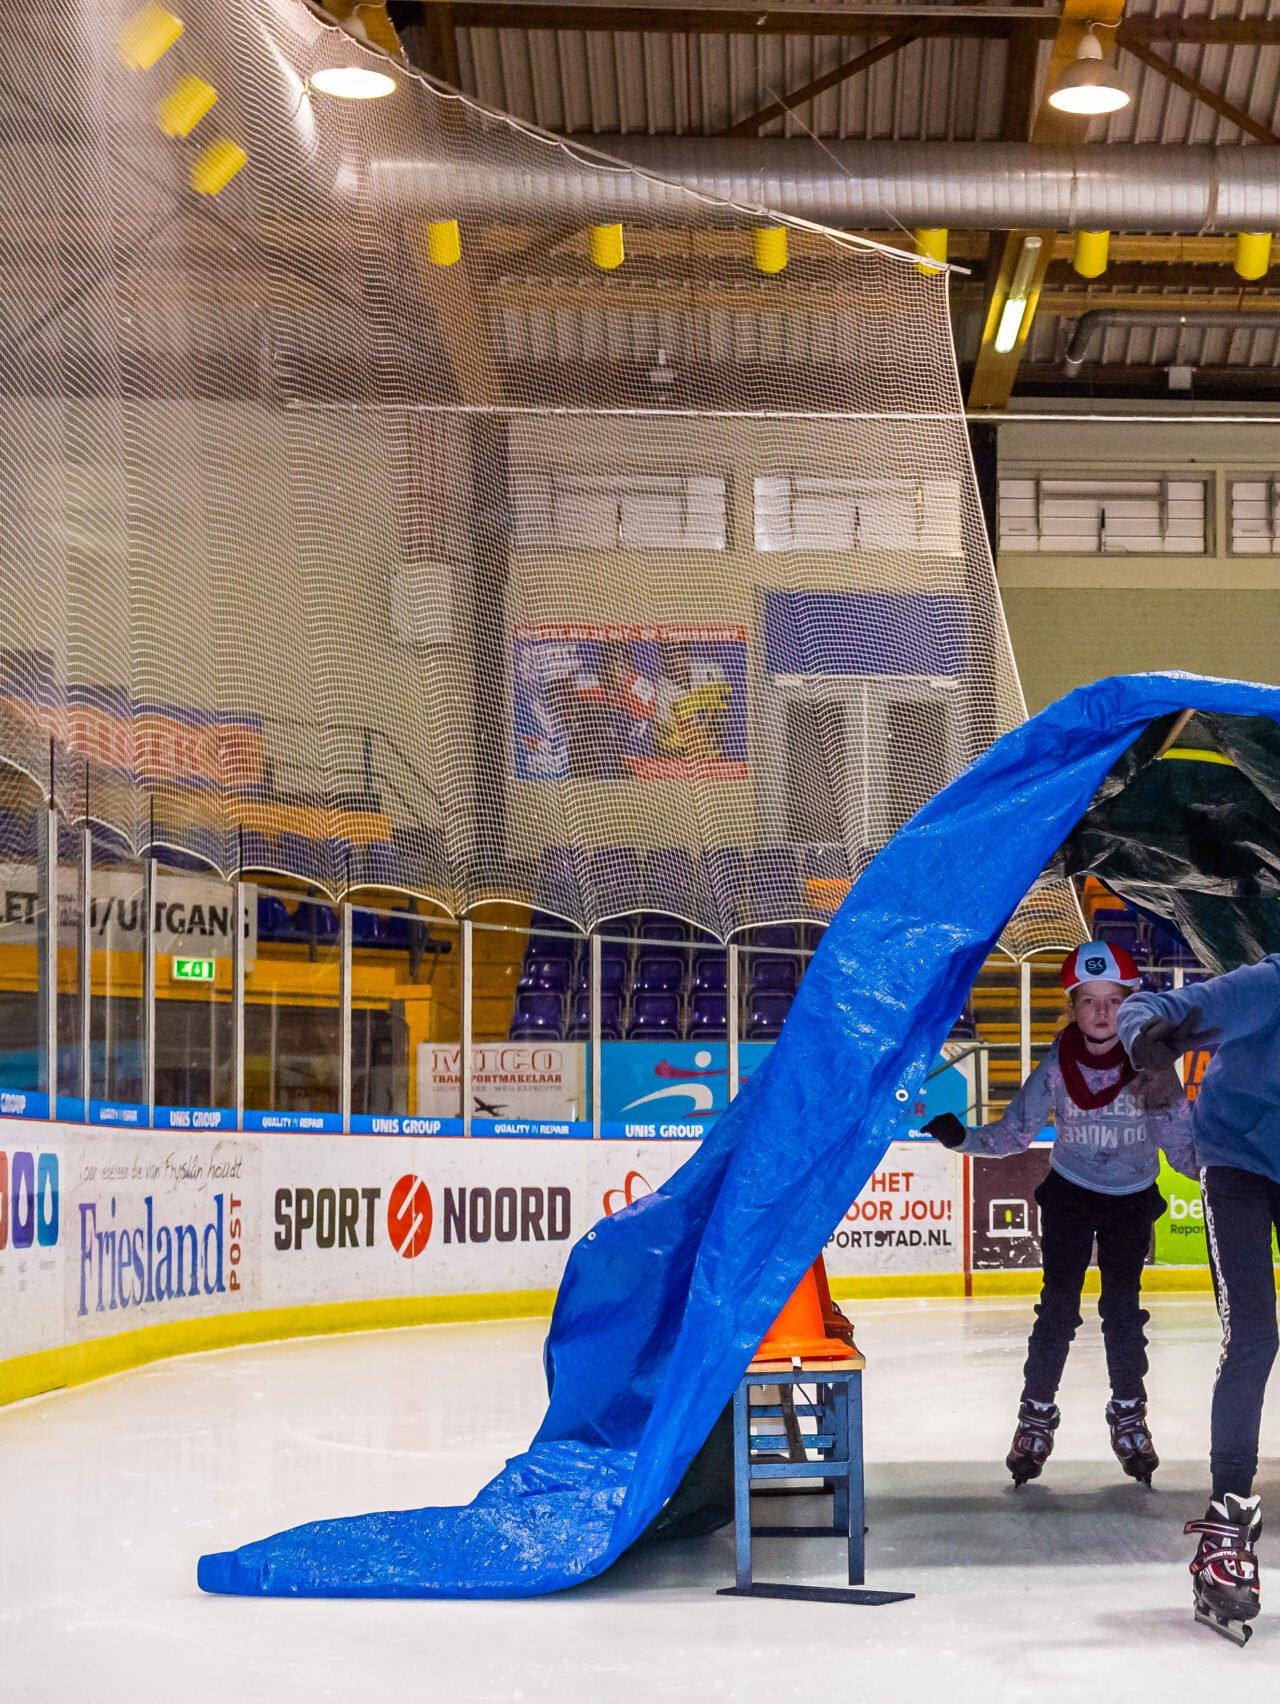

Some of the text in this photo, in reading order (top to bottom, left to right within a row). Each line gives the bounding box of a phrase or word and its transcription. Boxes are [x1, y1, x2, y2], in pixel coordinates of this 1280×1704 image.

[432, 1049, 563, 1073] MICO
[432, 1074, 562, 1084] TRANPORTMAKELAAR
[169, 1110, 222, 1128] UNIS GROUP
[262, 1116, 291, 1129] QUALITY
[299, 1117, 324, 1129] REPAIR
[372, 1118, 441, 1135] UNIS GROUP
[494, 1123, 570, 1135] QUALITY IN REPAIR
[625, 1124, 704, 1138] UNIS GROUP
[871, 1172, 914, 1192] HET
[844, 1200, 952, 1221] OOR JOU!
[1170, 1194, 1204, 1219] be
[274, 1187, 571, 1250] SPORT NOORD
[824, 1230, 952, 1248] PORTSTAD.NL
[1170, 1224, 1204, 1238] Repar
[78, 1193, 242, 1317] Friesland POST
